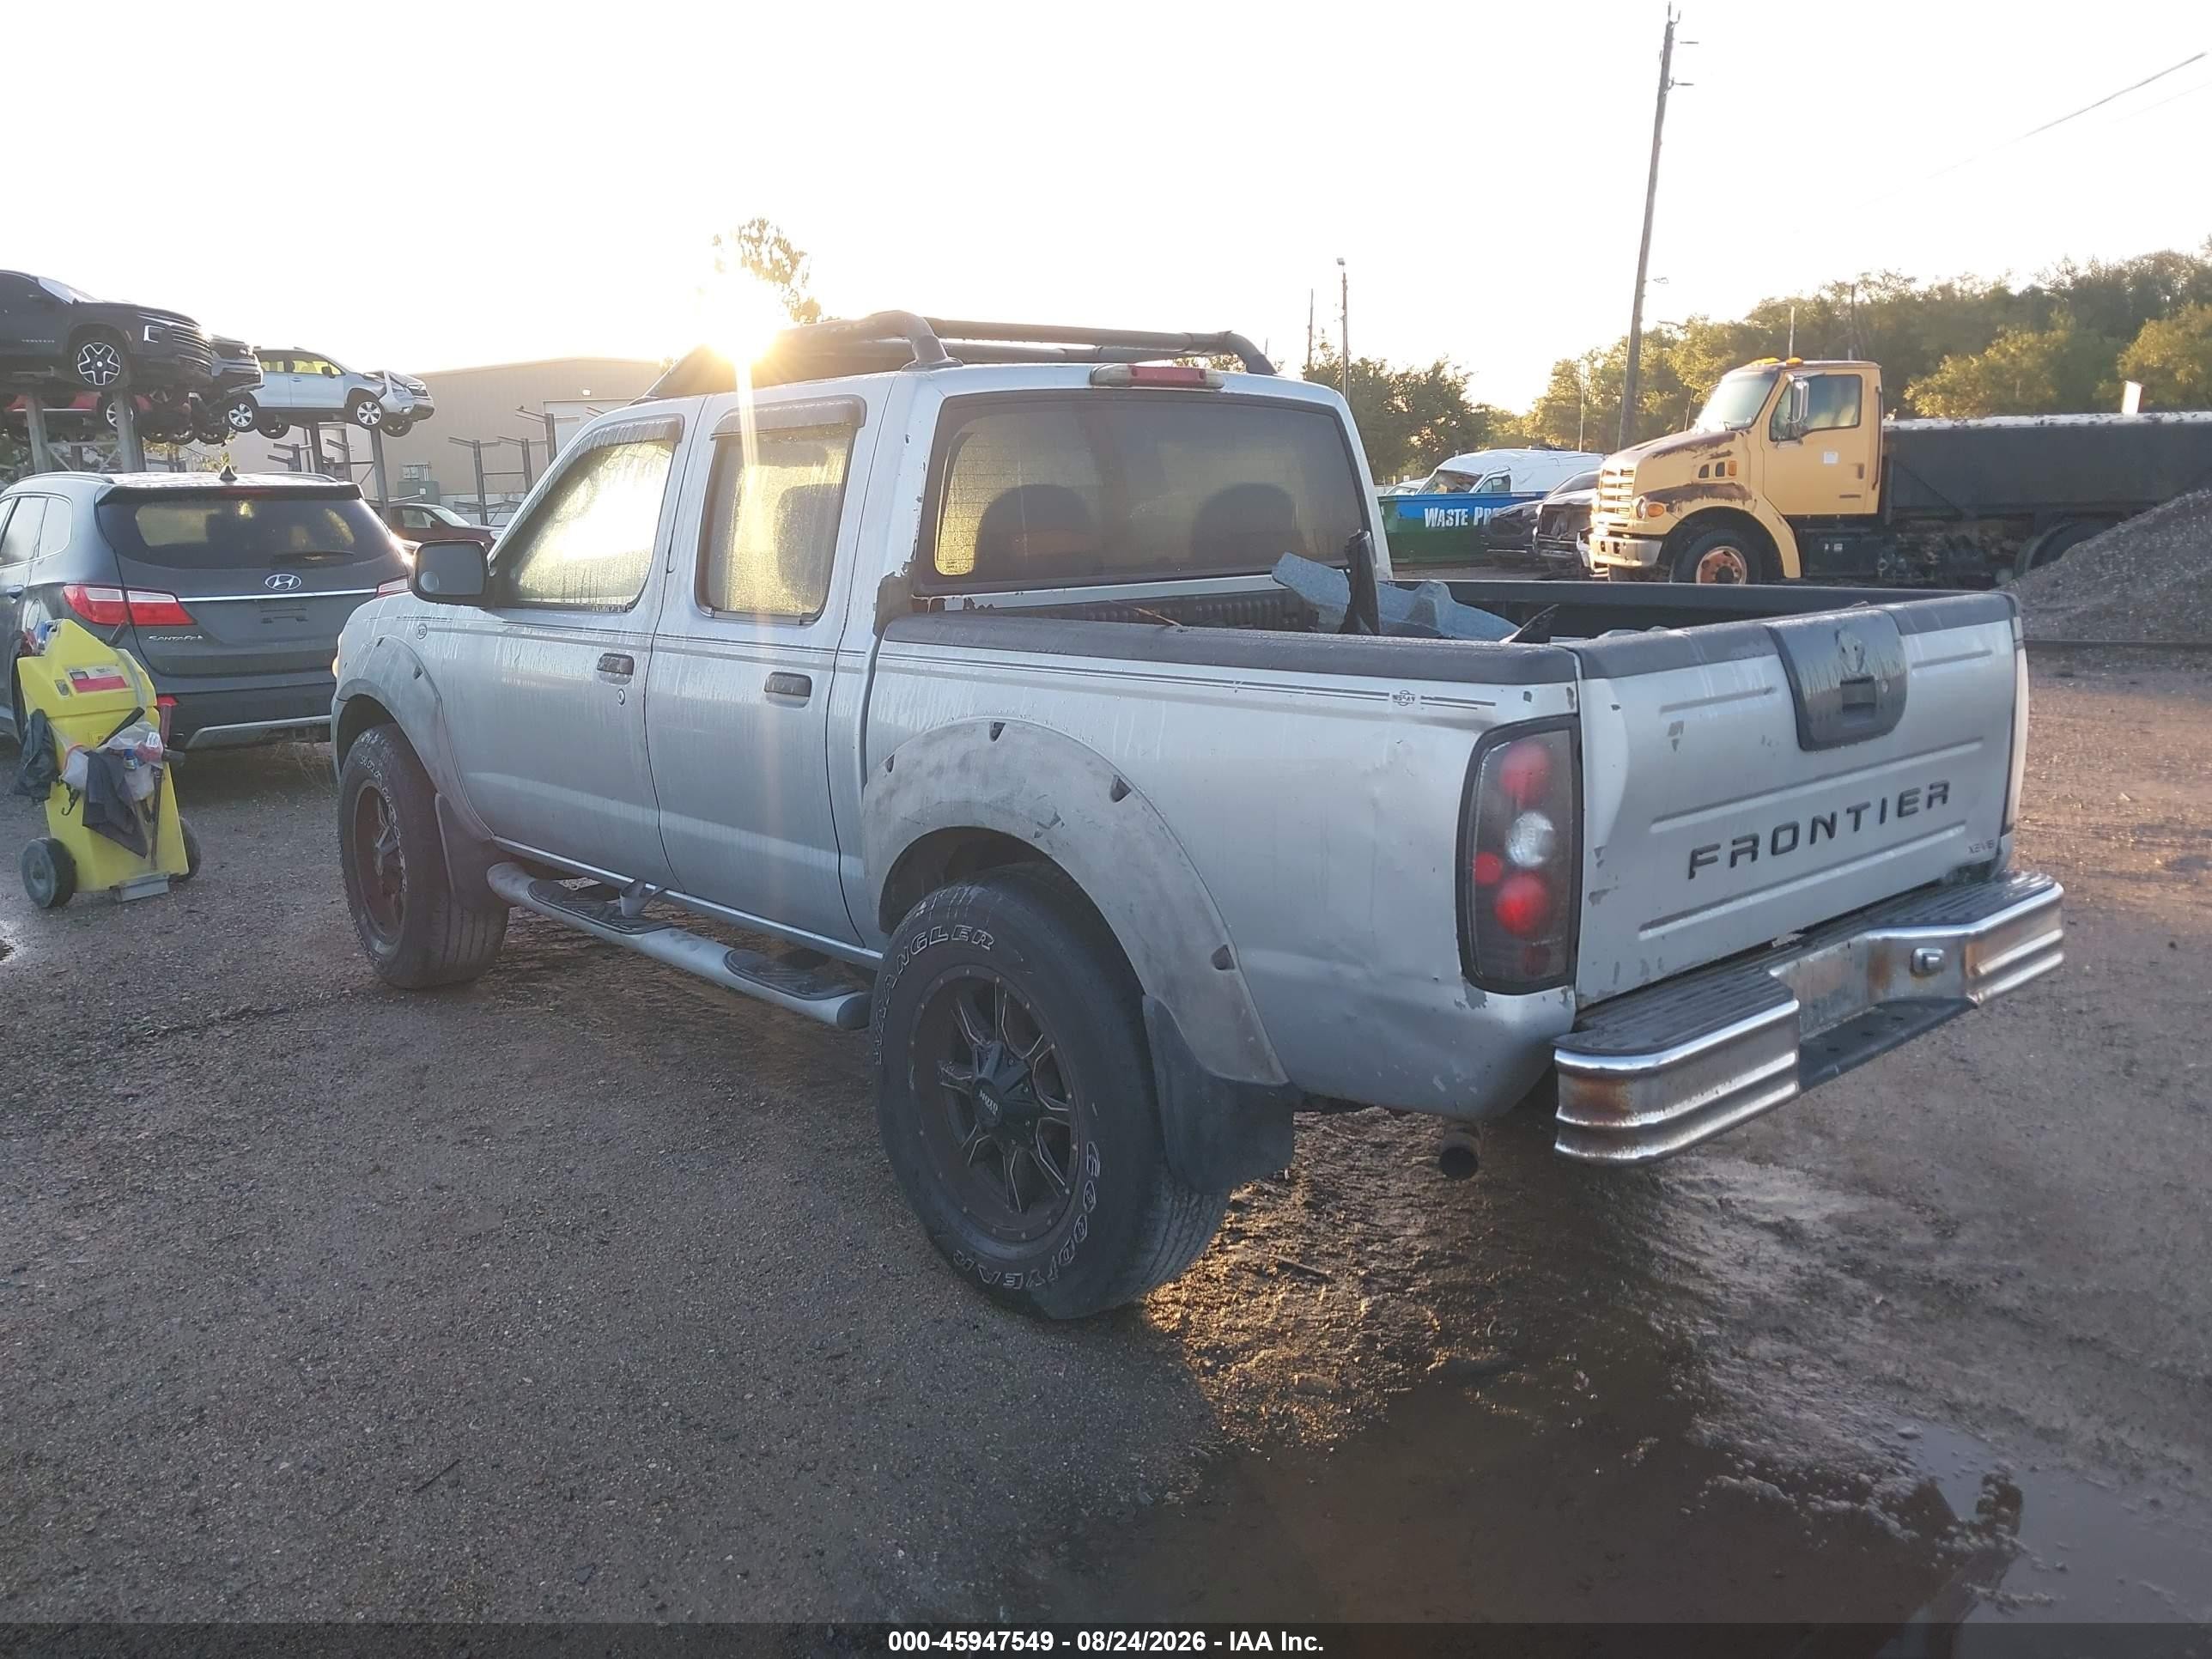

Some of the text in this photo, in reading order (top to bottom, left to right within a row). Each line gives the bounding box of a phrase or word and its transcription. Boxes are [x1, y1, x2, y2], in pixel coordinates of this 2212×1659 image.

[1424, 507, 1469, 527] WASTE
[1687, 780, 1950, 880] FRONTIER
[873, 924, 994, 1066] WRANGLER
[952, 1140, 1101, 1290] GOODYEAR
